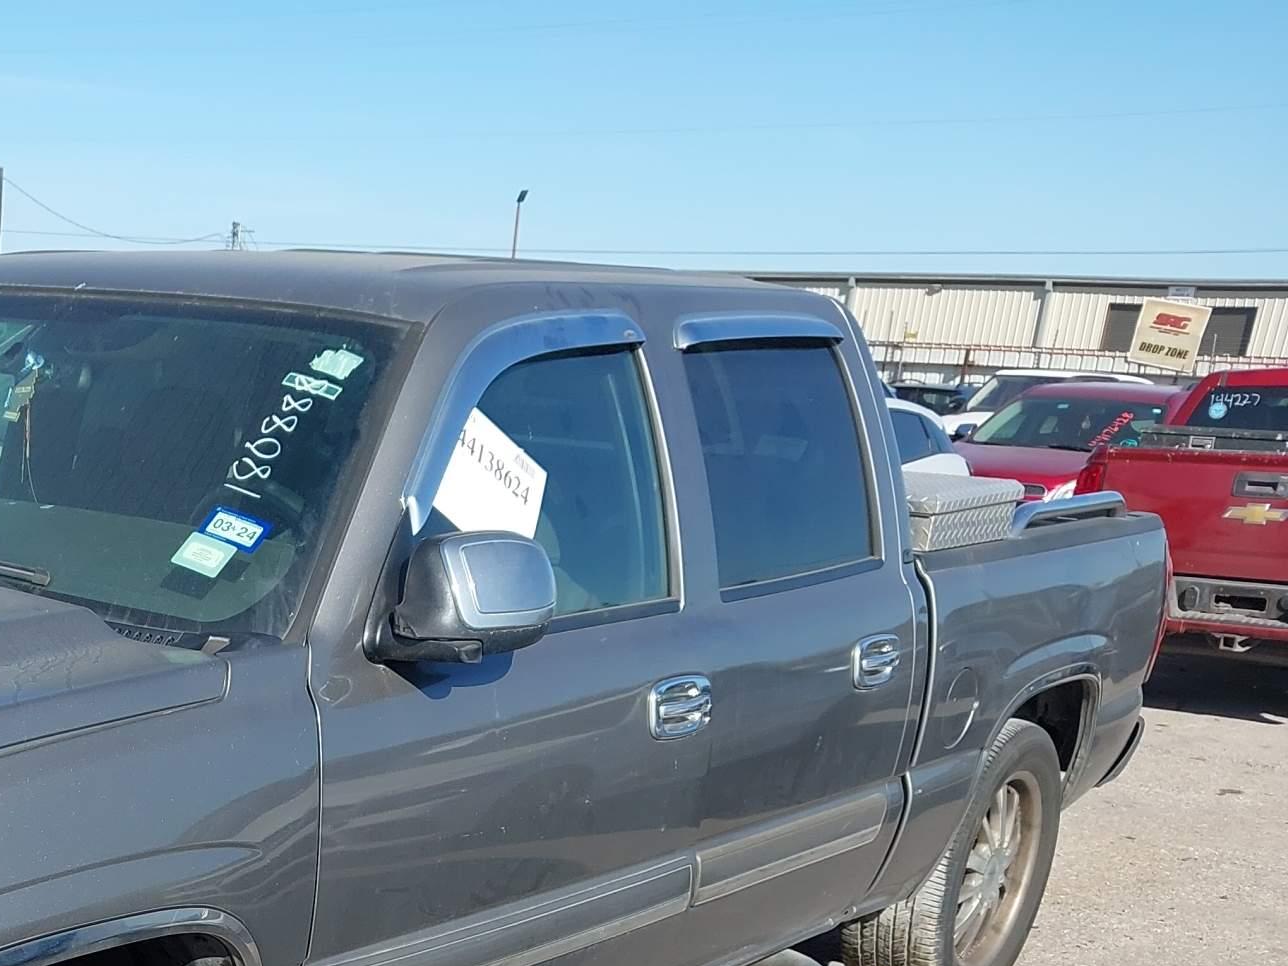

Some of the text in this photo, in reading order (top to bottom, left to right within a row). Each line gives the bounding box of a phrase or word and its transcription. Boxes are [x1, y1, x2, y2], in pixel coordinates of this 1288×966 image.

[1139, 341, 1190, 360] DROP ZONE
[458, 429, 531, 505] 44138624
[213, 518, 233, 532] 03
[236, 526, 257, 541] 24
